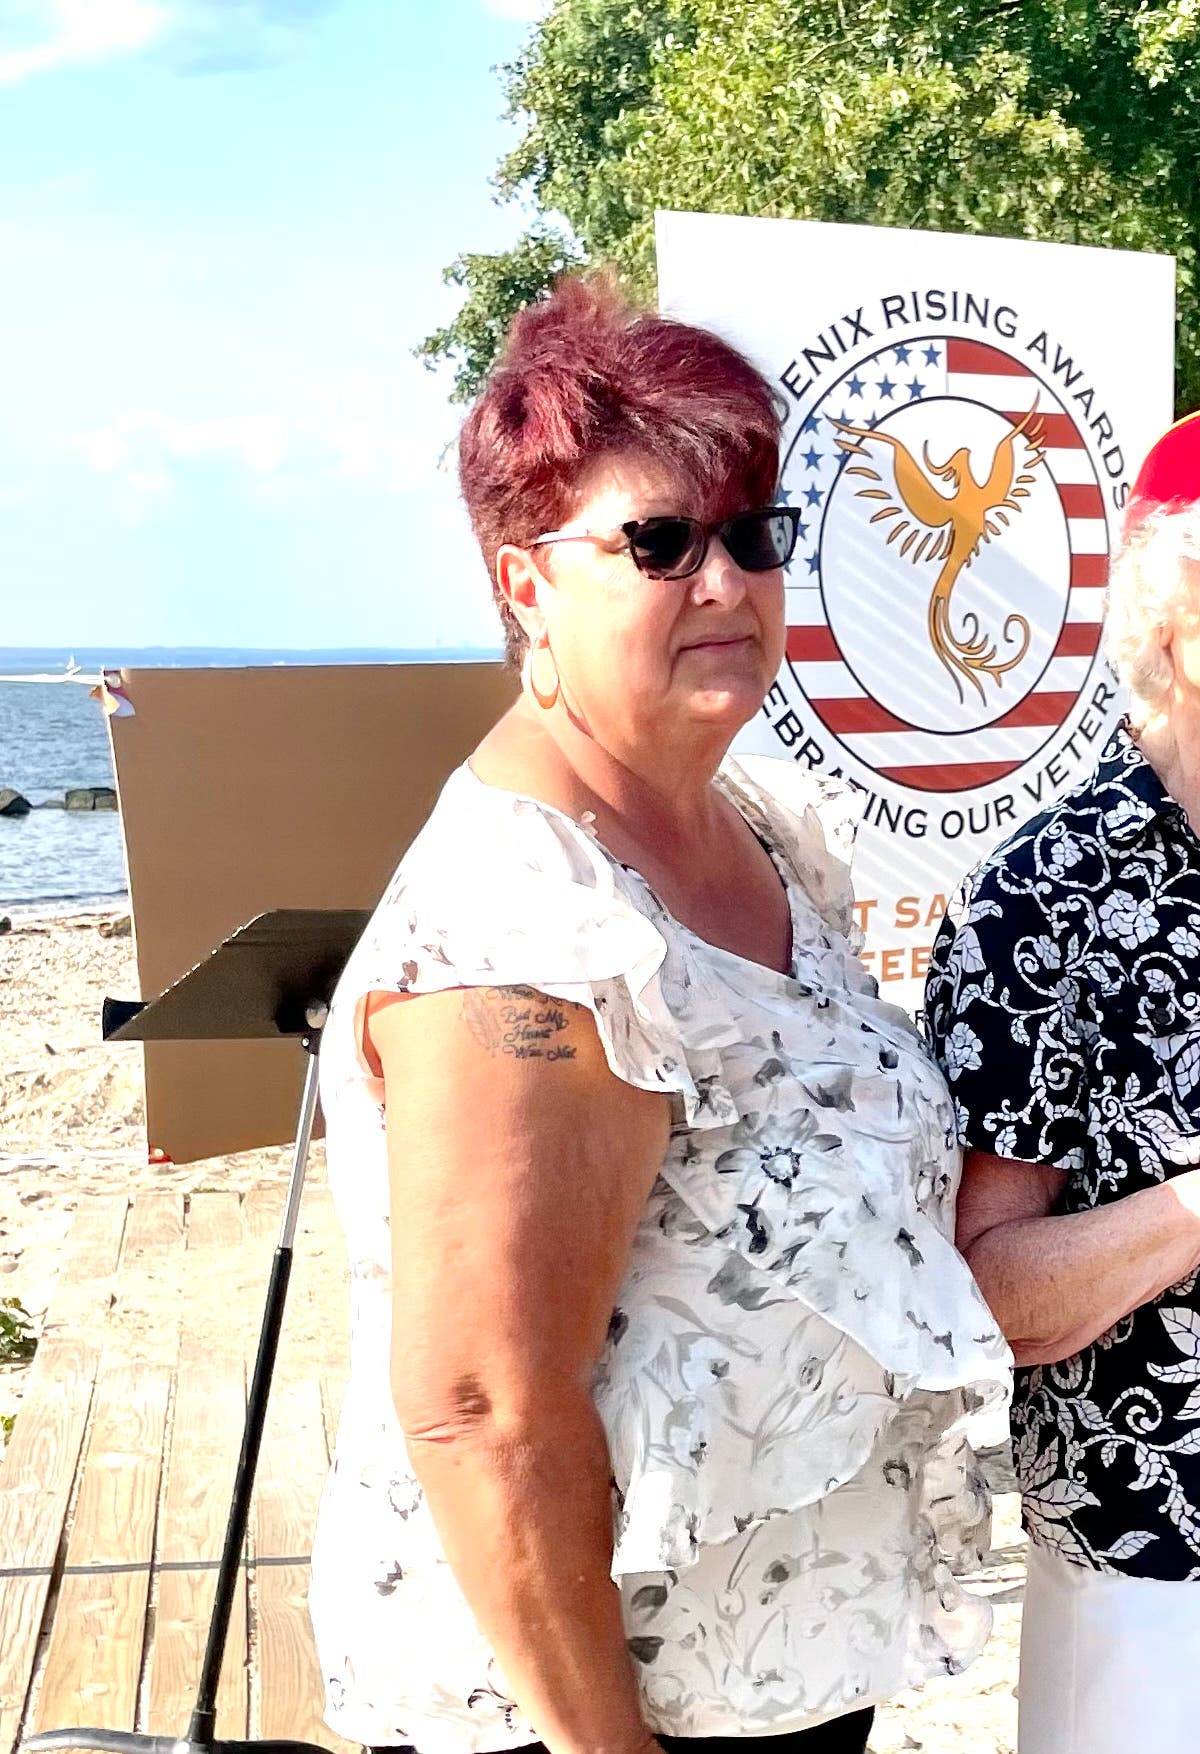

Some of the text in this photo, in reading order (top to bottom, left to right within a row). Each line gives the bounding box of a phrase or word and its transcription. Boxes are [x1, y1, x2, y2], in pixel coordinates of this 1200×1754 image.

[774, 289, 1131, 511] ENIX RISING AWARDS
[762, 660, 1121, 839] EBRING OUR VETER
